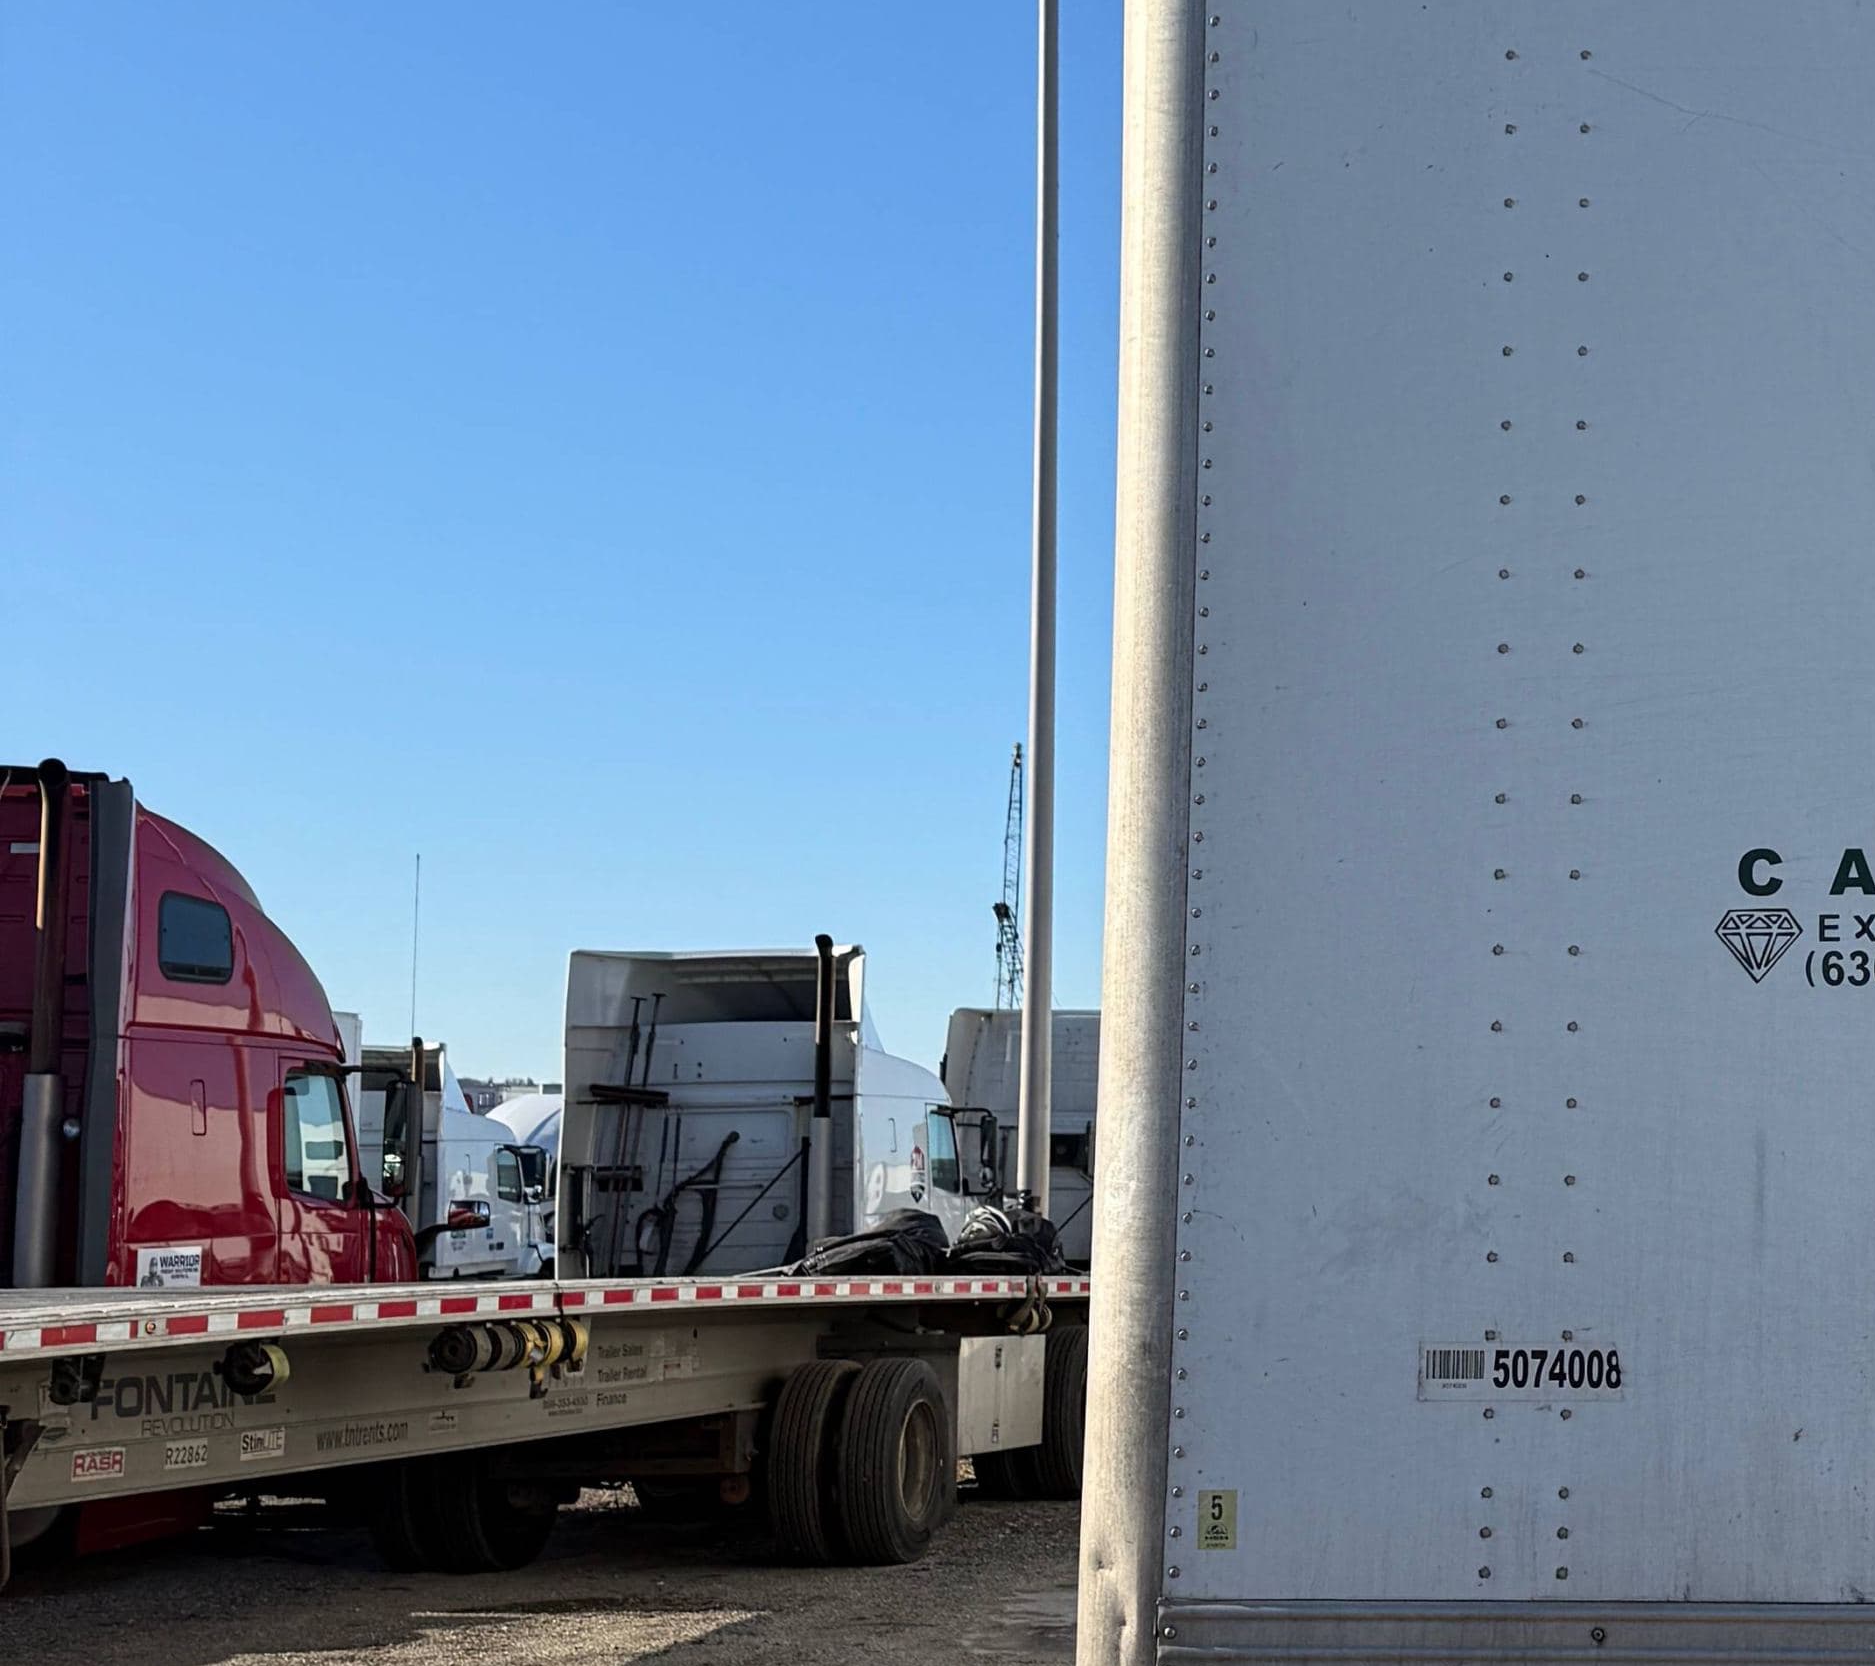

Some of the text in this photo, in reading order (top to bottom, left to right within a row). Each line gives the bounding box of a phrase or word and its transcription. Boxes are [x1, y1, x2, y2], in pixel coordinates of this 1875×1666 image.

[160, 1254, 200, 1268] WARRIOR
[1492, 1349, 1622, 1389] 5074008
[141, 1411, 235, 1437] REVOLUTION
[165, 1444, 208, 1466] R22862
[1211, 1495, 1223, 1521] 5
